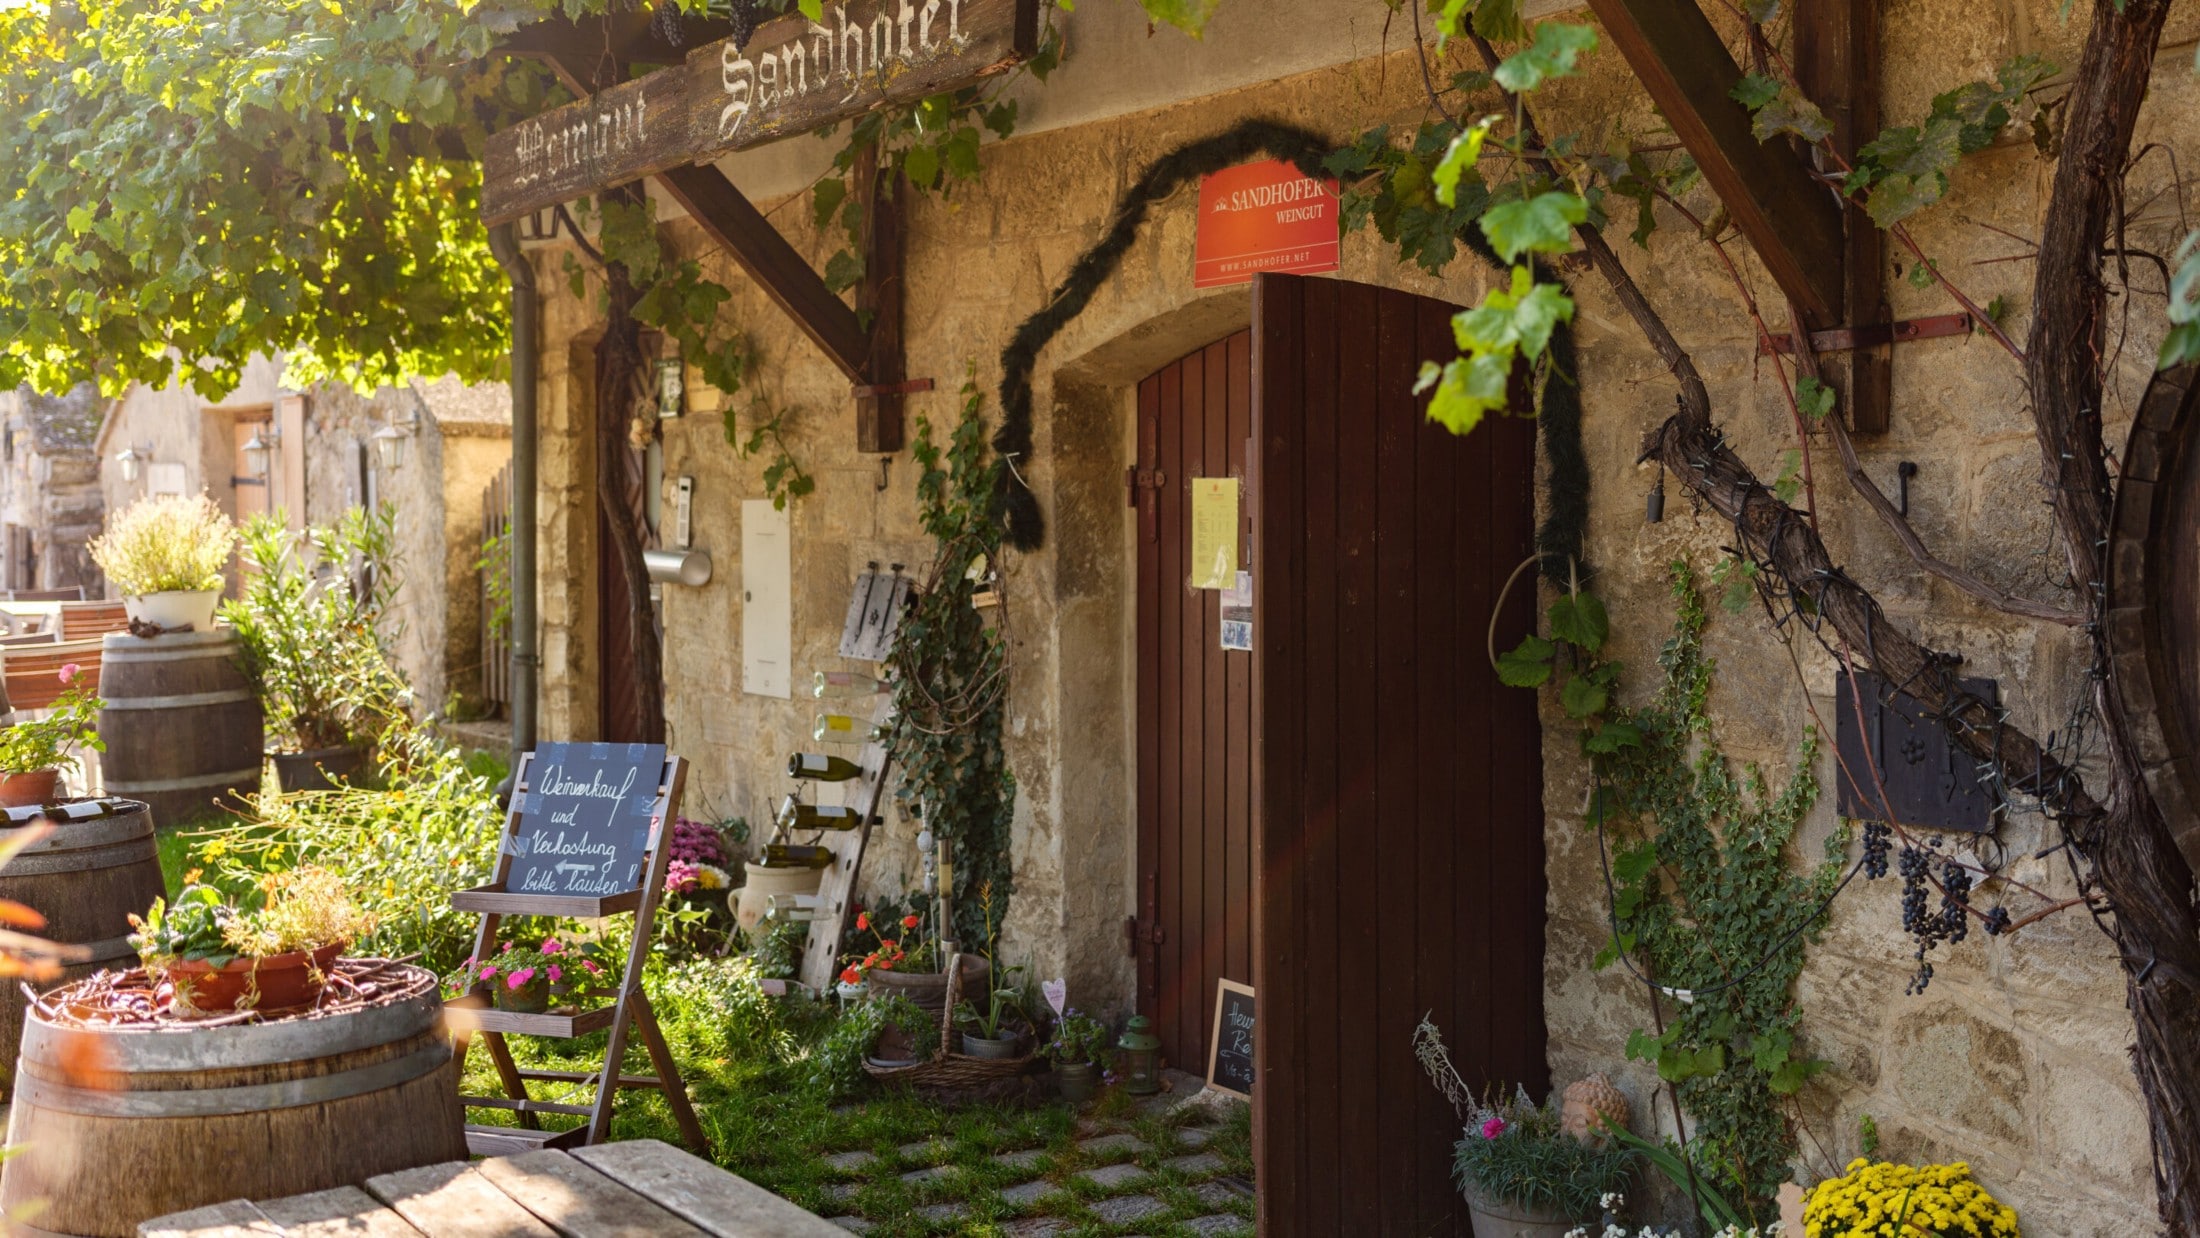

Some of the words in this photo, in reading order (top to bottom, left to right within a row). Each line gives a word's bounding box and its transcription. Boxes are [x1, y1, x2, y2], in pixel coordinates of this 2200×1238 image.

[1231, 178, 1325, 212] SANDHOFER
[1276, 204, 1325, 224] WEINGUT
[1220, 252, 1310, 272] WWW.SANDHOFER.NET
[539, 764, 637, 827] Weinverkauf
[550, 803, 580, 826] und
[532, 829, 617, 873] Verkostung
[520, 866, 558, 892] bitte
